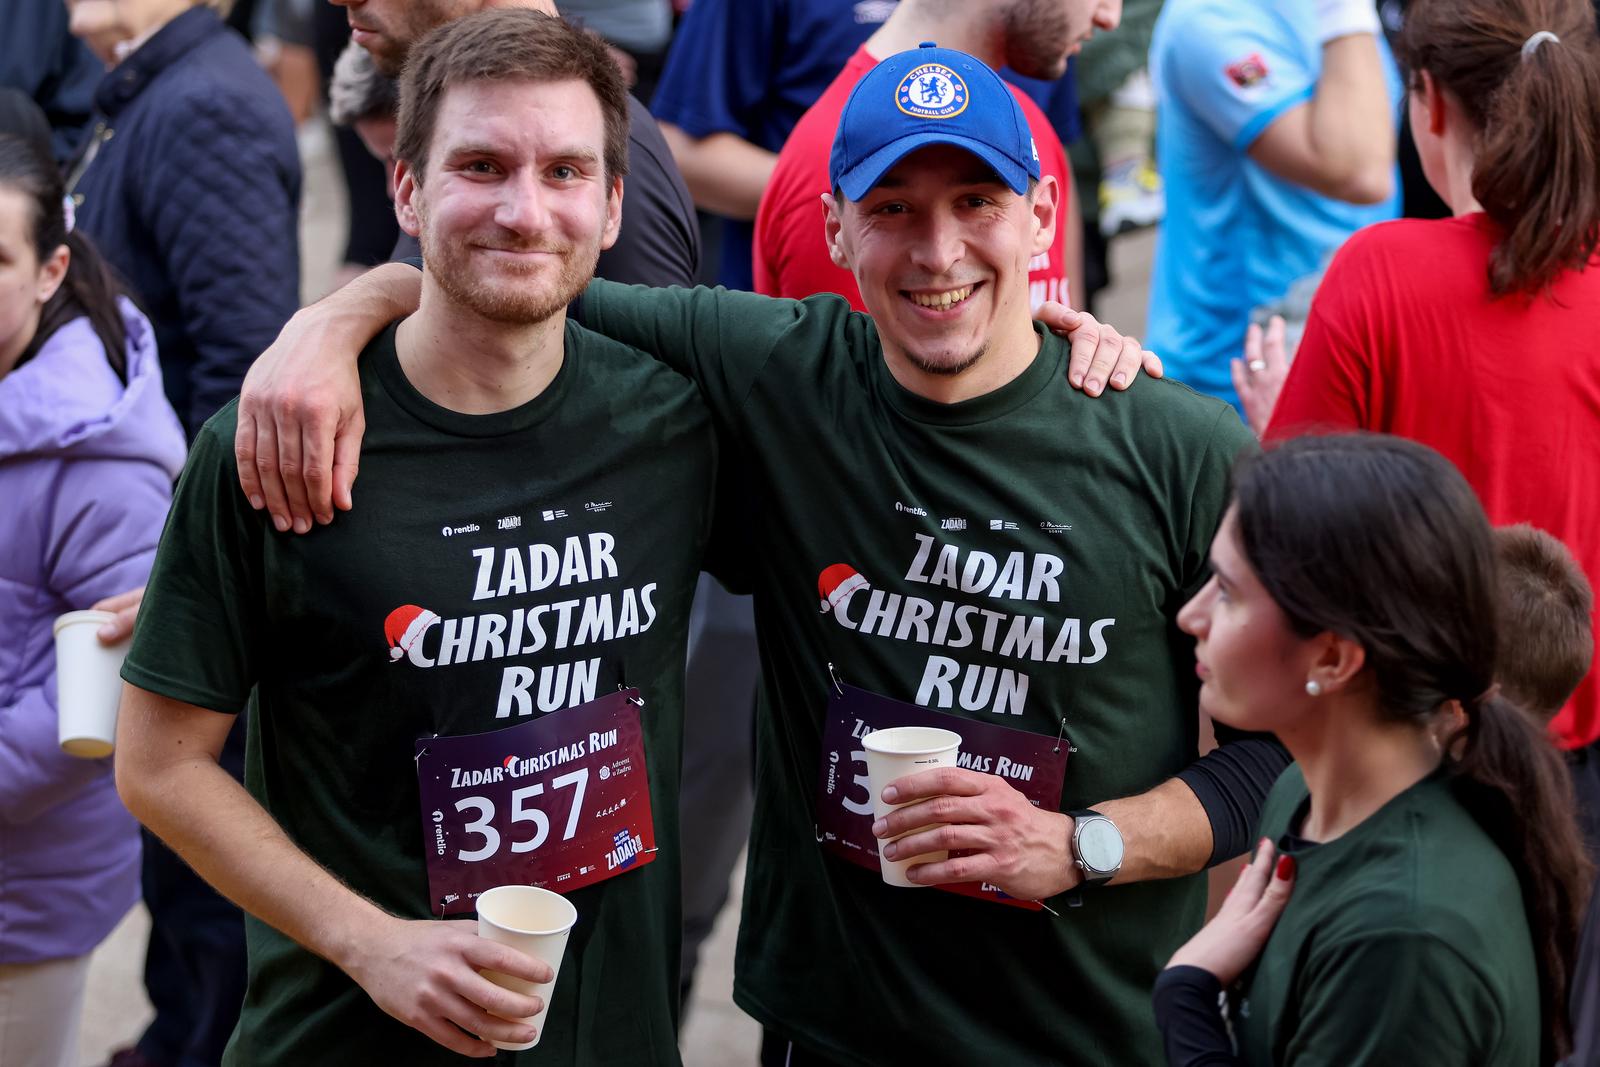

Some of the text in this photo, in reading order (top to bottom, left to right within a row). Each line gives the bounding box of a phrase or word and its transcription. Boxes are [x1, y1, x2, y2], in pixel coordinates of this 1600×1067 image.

[909, 66, 952, 80] CHELSEA
[910, 106, 955, 115] FOOTBALL CLUB
[453, 523, 480, 534] rentlio
[903, 505, 928, 517] rentlio
[472, 532, 618, 601] ZADAR
[904, 533, 1064, 602] ZADAR
[407, 582, 657, 668] CHRISTMAS
[833, 583, 1116, 664] CHRISTMAS
[495, 657, 601, 719] RUN
[914, 655, 1029, 716] RUN
[450, 728, 617, 789] ZADAR CHRISTMAS RUN
[827, 764, 837, 794] rentlio
[995, 756, 1034, 781] RUN
[434, 824, 447, 856] rentlio
[454, 767, 589, 862] 357
